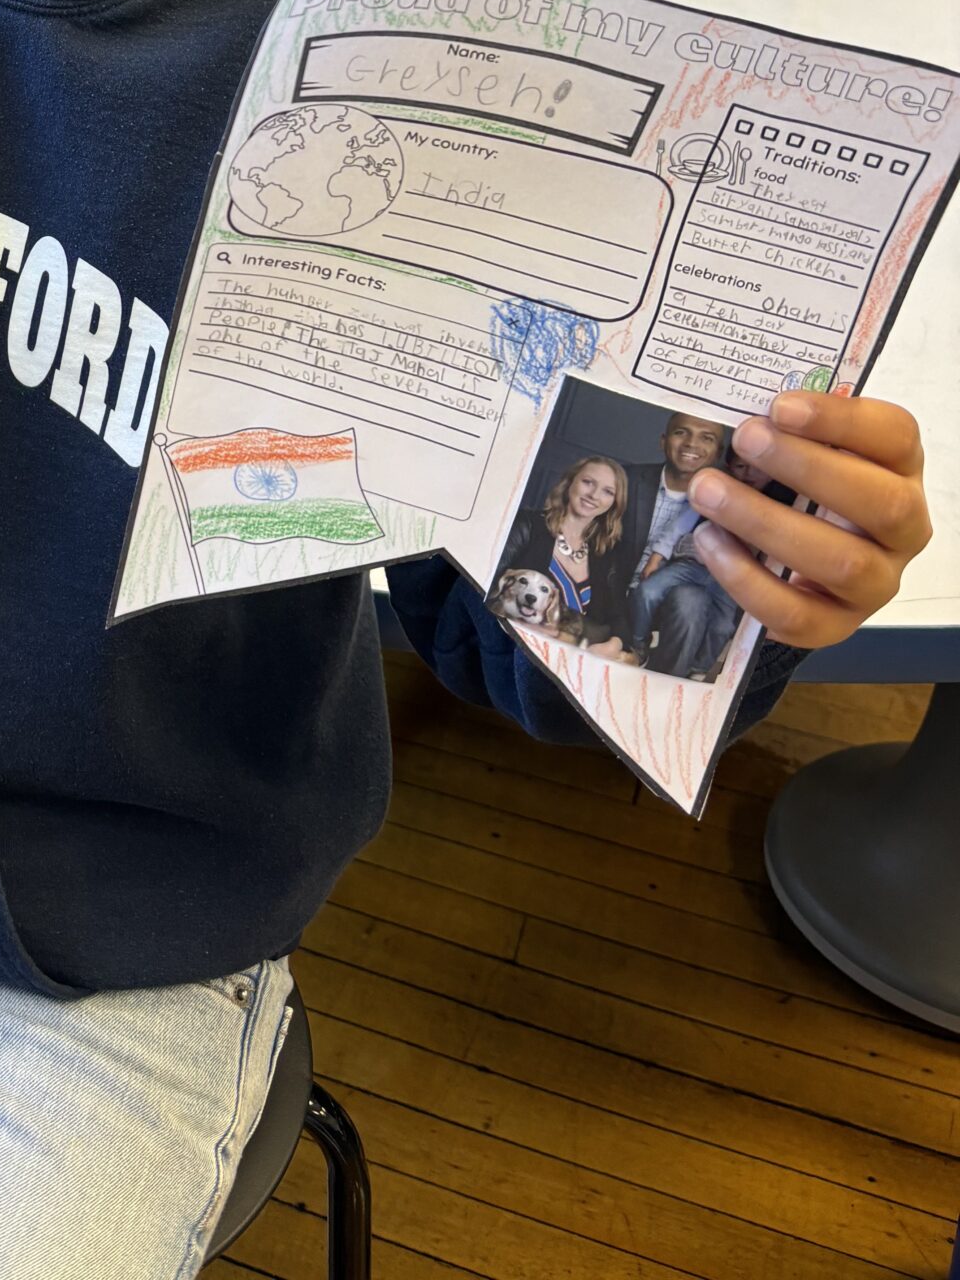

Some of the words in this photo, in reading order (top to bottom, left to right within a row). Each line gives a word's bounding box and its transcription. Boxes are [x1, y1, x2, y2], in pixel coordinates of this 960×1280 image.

[447, 43, 501, 64] Name:
[563, 3, 665, 56] my
[674, 32, 954, 123] culture!
[404, 131, 429, 147] My
[431, 138, 499, 160] country:
[753, 167, 787, 185] food
[763, 146, 862, 184] Traditions:
[413, 172, 507, 210] India
[242, 253, 332, 280] Interesting
[336, 267, 387, 292] Facts:
[673, 262, 763, 293] celebrations
